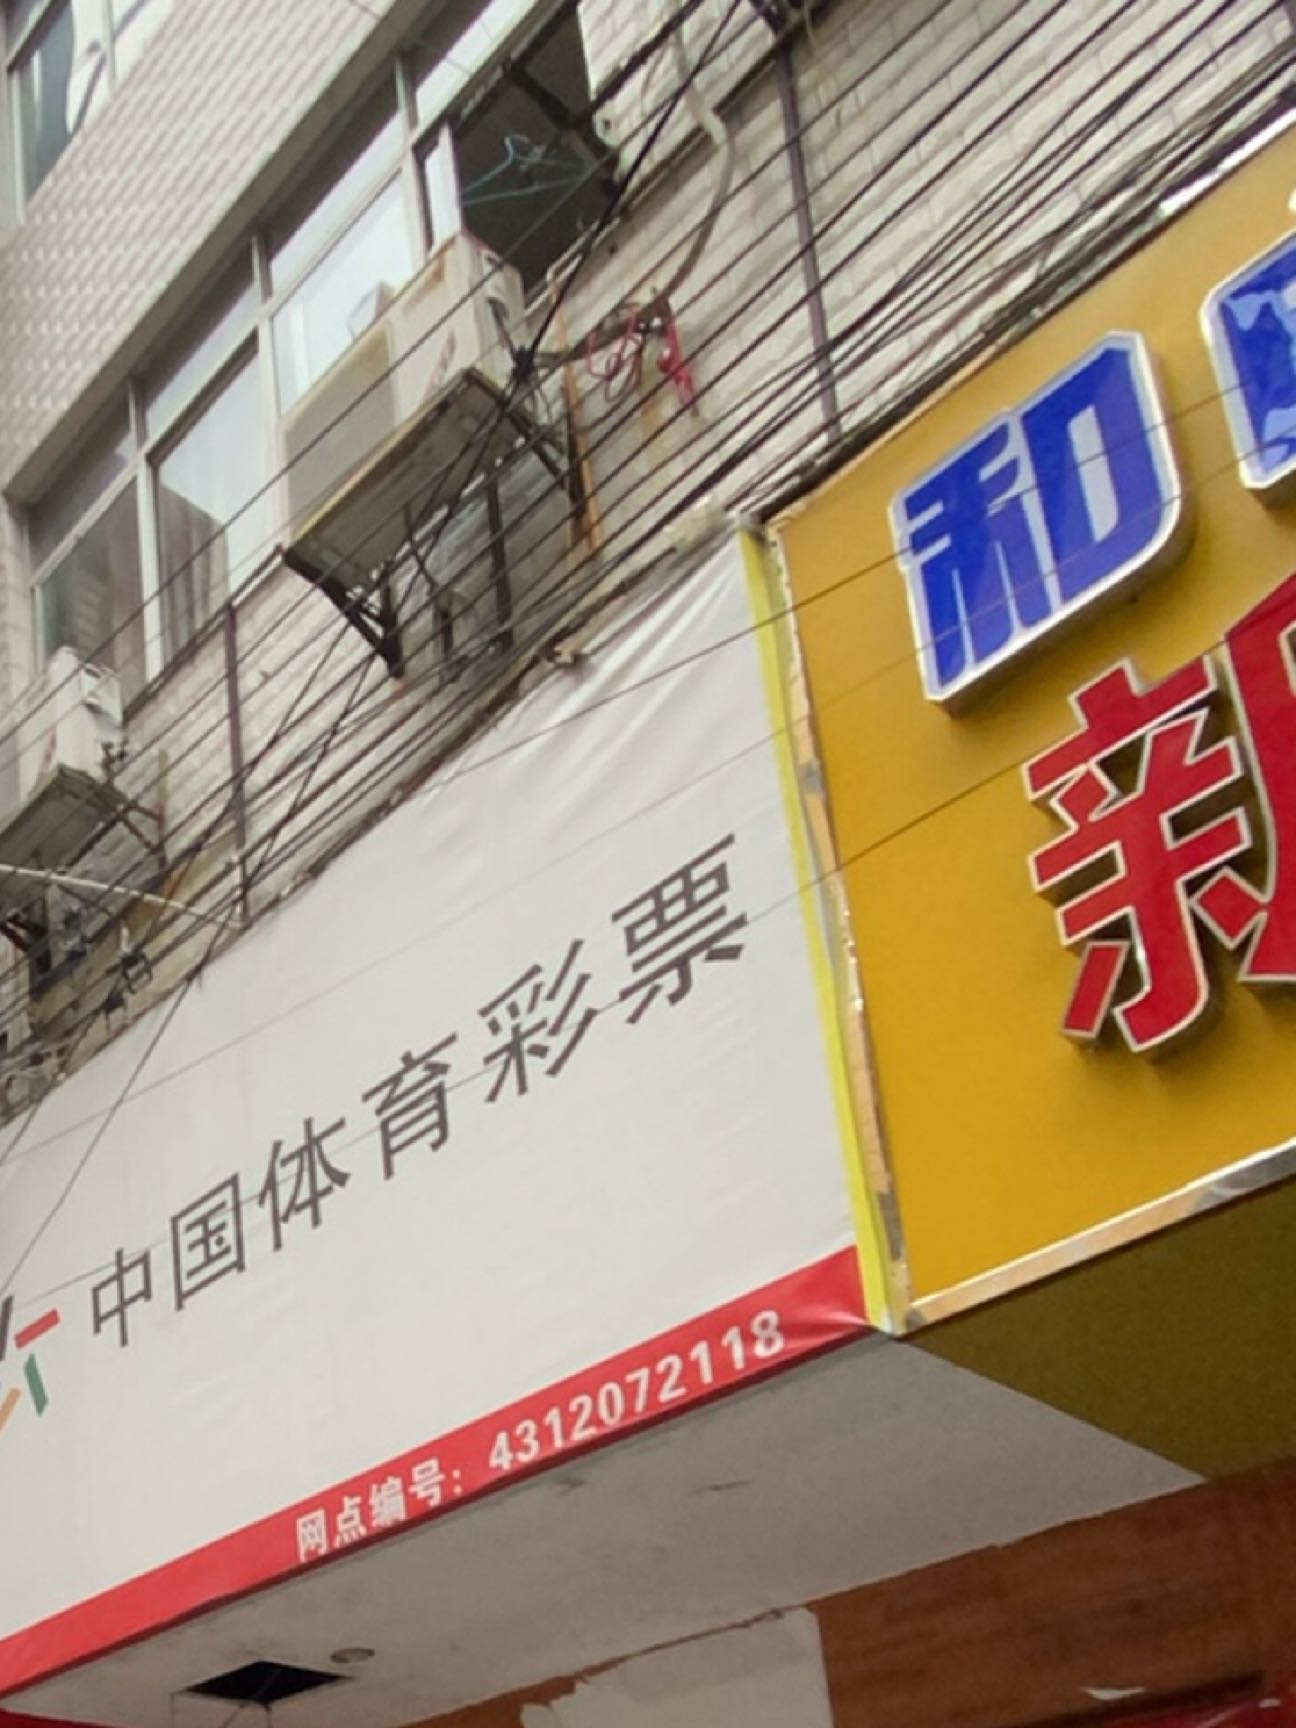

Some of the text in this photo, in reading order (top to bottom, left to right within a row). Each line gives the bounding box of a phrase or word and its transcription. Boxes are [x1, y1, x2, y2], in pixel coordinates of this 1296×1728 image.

[90, 833, 748, 1347] 中国体育彩票
[488, 1308, 787, 1473] 4312072118
